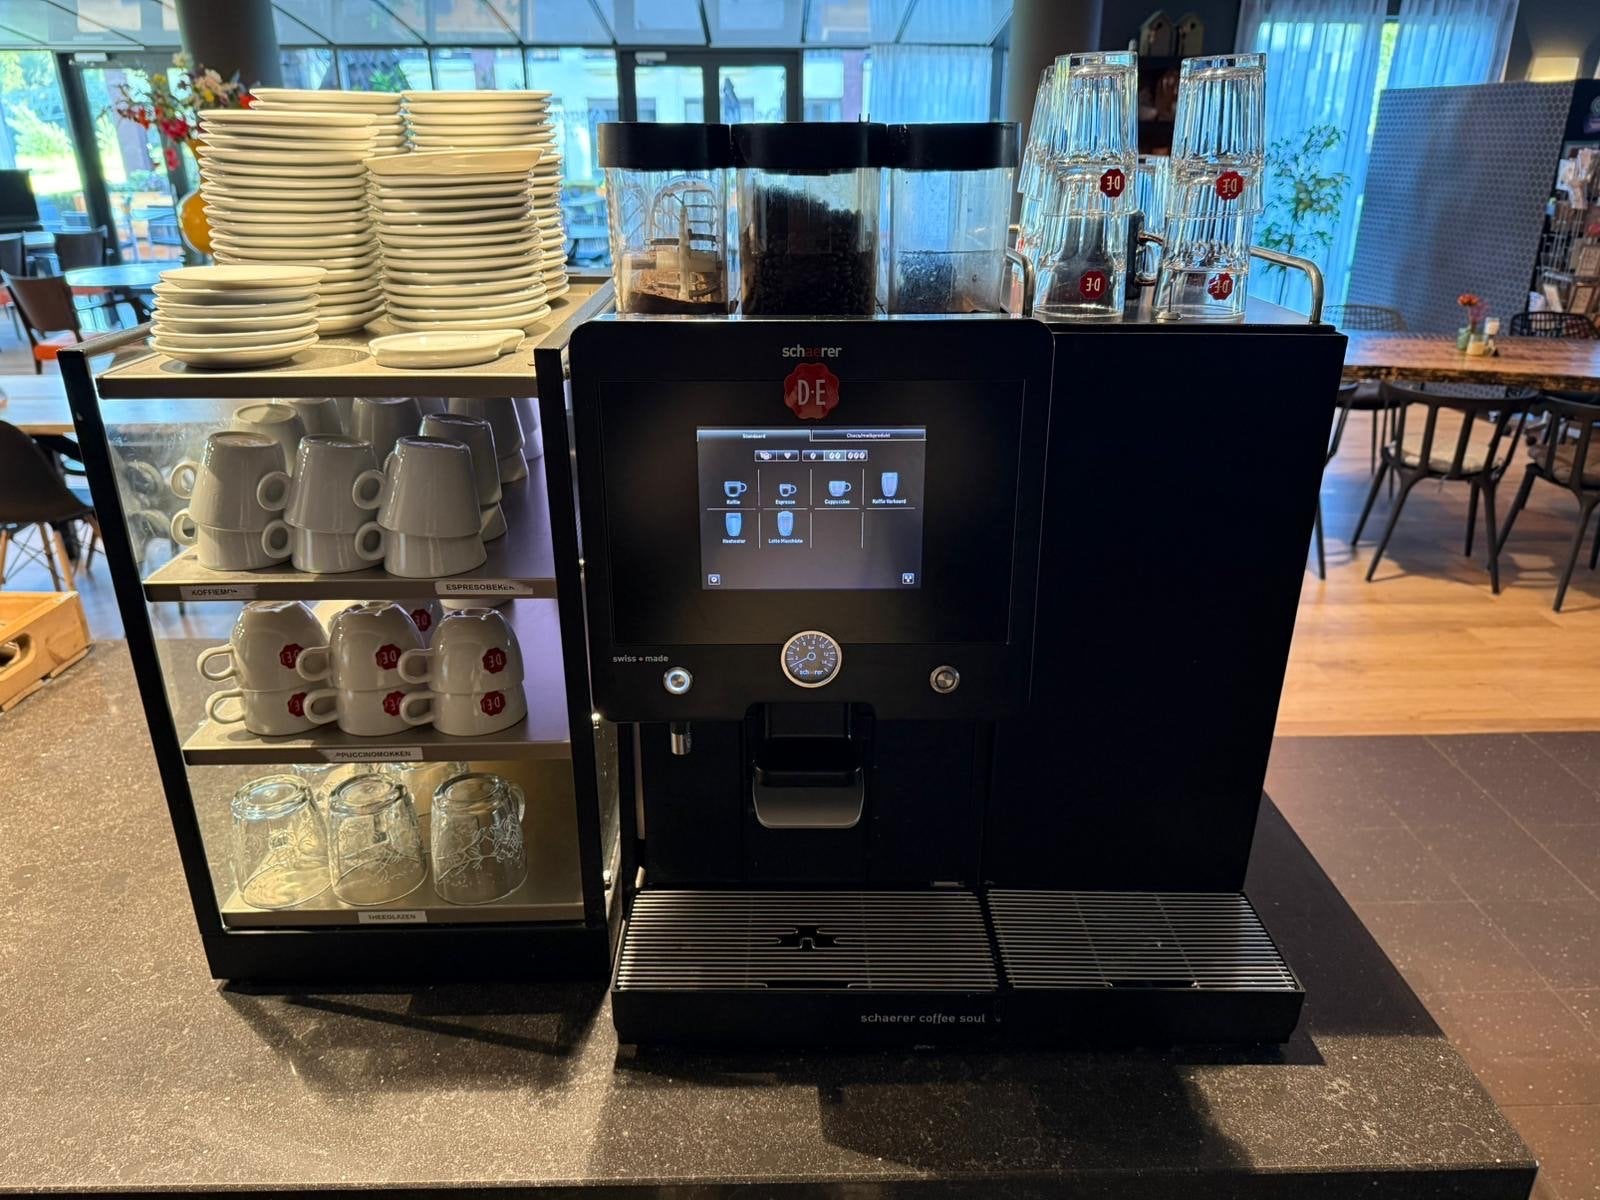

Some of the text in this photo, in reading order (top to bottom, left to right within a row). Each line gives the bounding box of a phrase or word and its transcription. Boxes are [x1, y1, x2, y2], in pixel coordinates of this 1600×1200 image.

[782, 344, 842, 358] schaerer
[612, 654, 669, 663] swiss made
[860, 1013, 986, 1024] schaerer coffee soul
